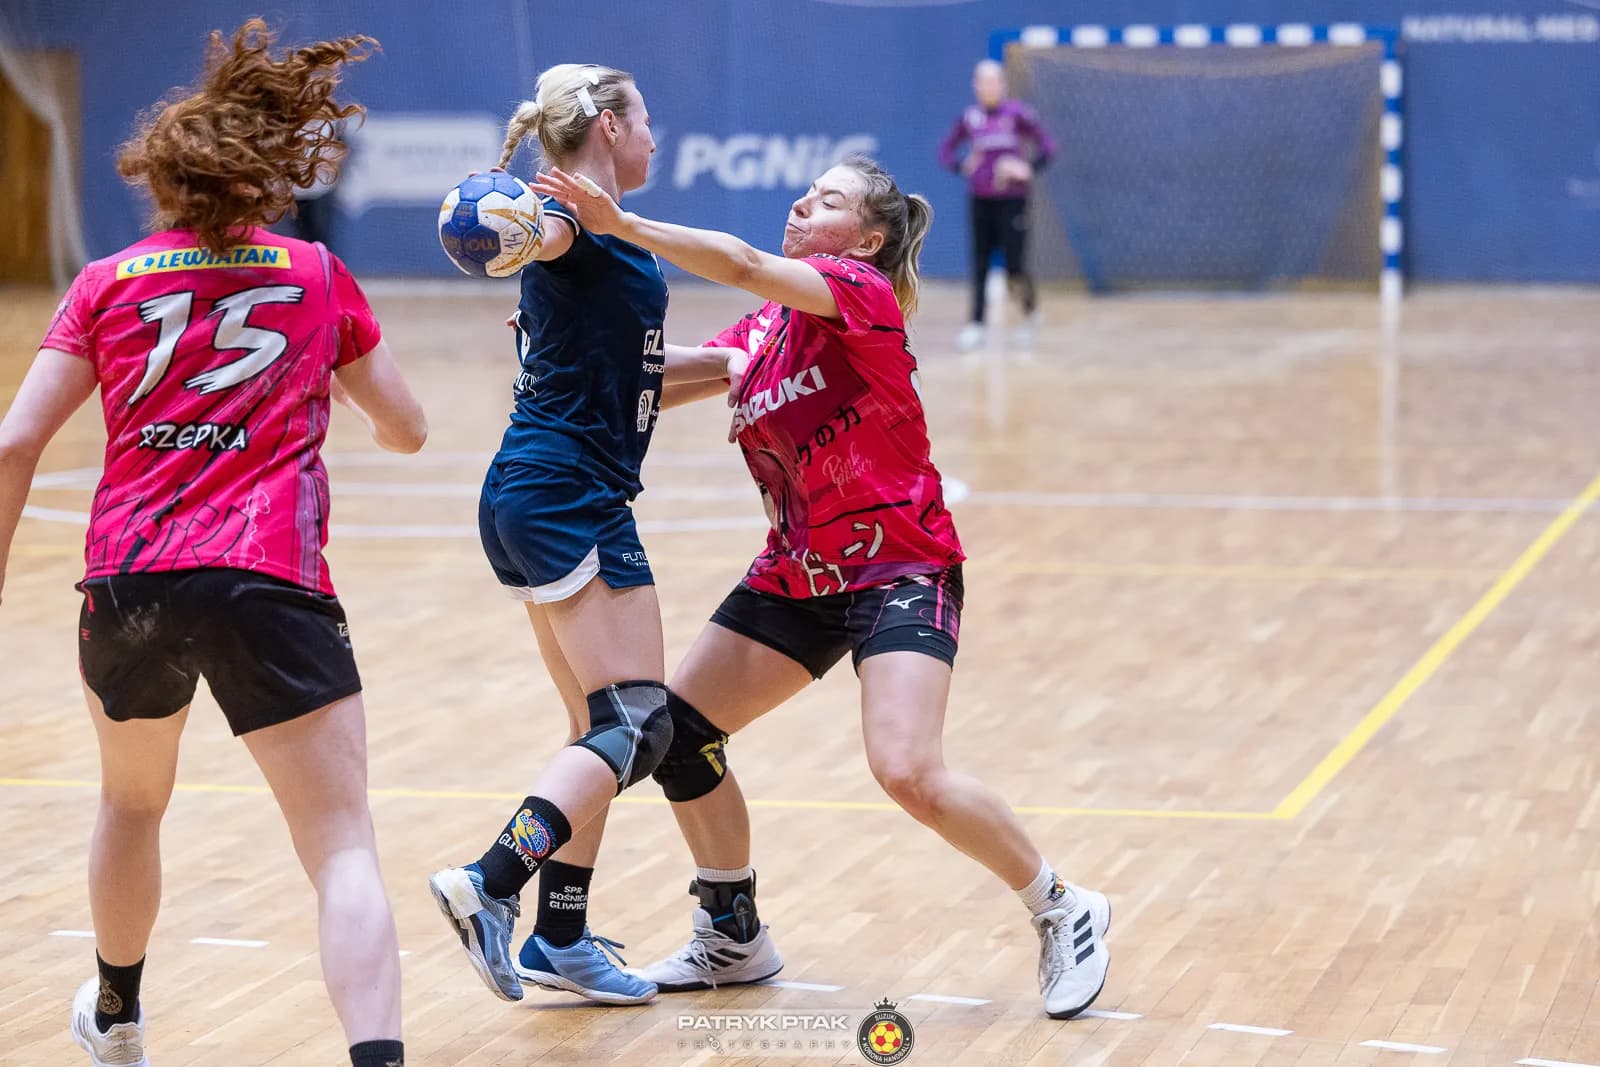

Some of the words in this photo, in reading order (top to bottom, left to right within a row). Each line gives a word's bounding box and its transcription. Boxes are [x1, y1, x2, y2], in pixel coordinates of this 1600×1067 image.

[130, 286, 304, 405] 15
[138, 424, 248, 451] RZEPKA
[499, 833, 538, 871] GLIWICE
[564, 885, 582, 894] SPR
